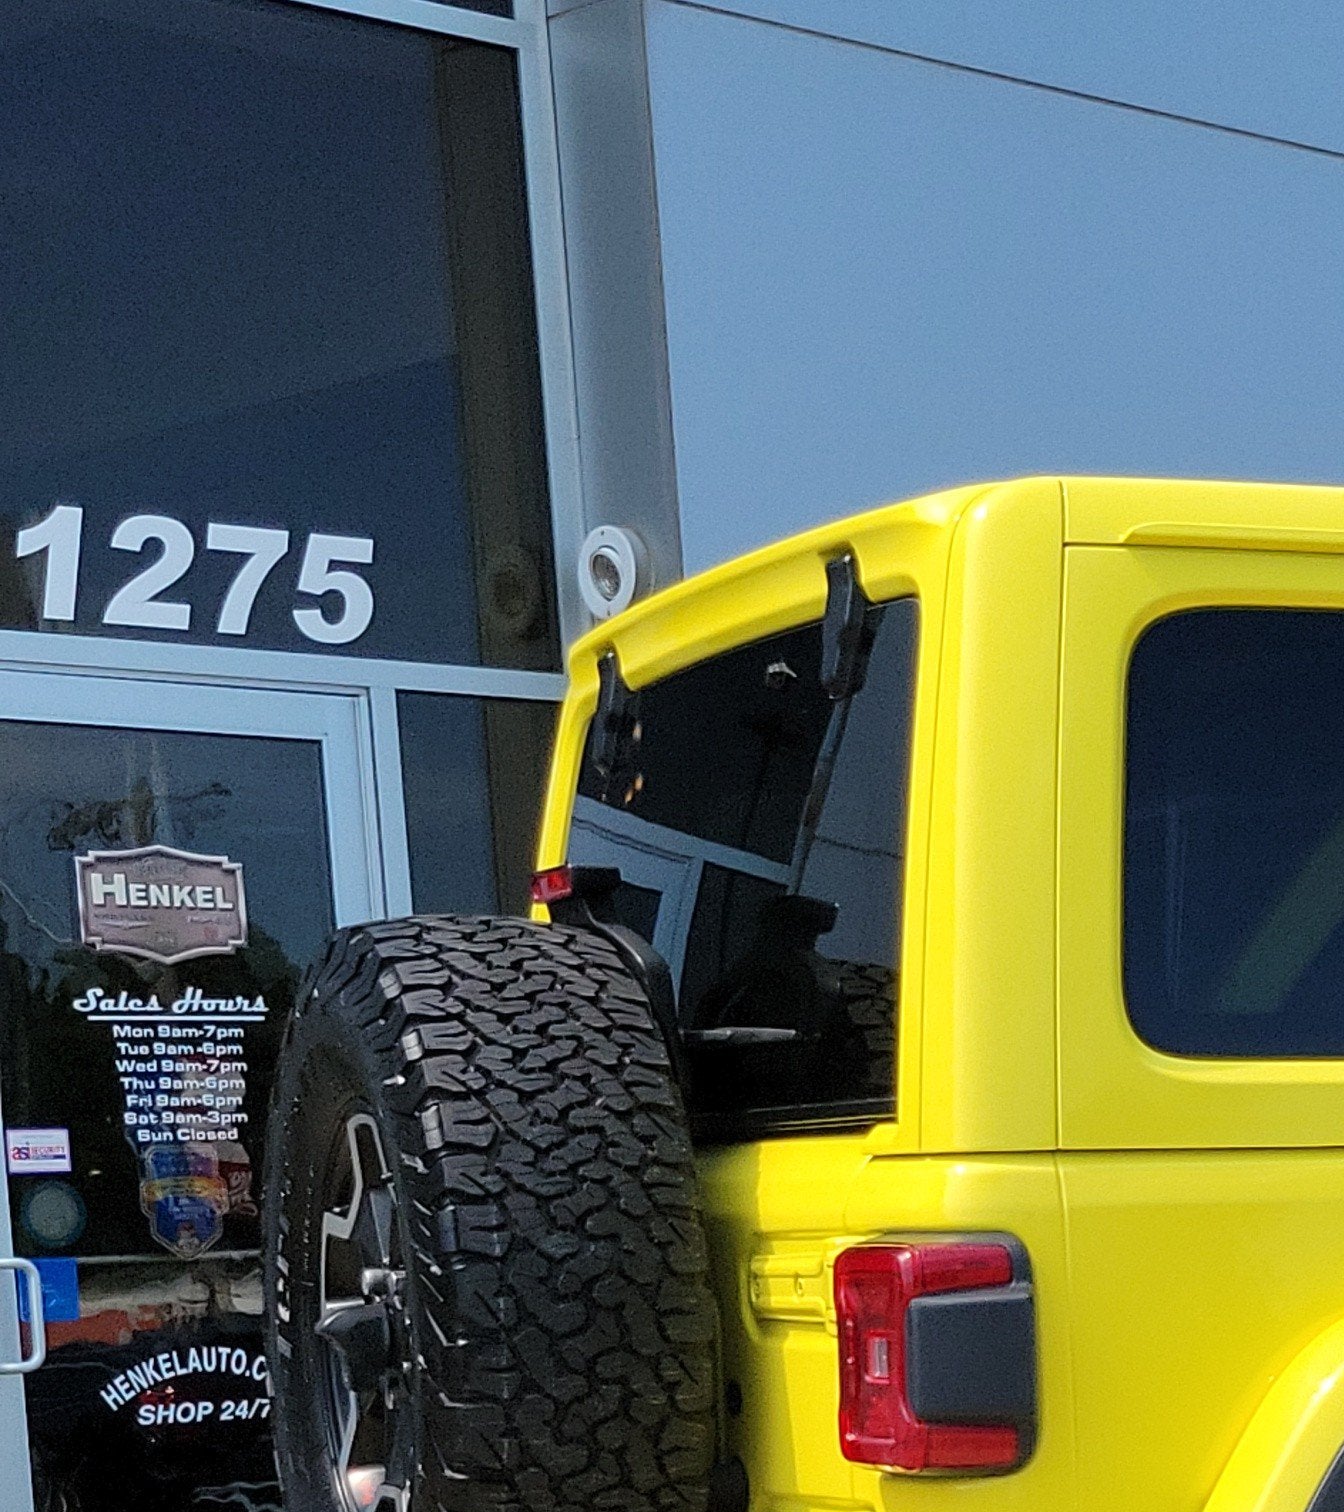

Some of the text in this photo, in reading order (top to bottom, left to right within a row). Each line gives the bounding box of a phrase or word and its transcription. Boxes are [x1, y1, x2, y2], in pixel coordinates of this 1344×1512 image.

[16, 504, 375, 645] 1275
[90, 872, 234, 910] HENKEL
[73, 986, 269, 1013] Sales Hours
[112, 1025, 244, 1040] Mon 9am-7pm
[116, 1042, 150, 1055] Tue
[115, 1059, 248, 1075] Wed 9am-7pm
[119, 1076, 155, 1090] Thu
[126, 1094, 153, 1108] Fri
[123, 1111, 248, 1127] Sat 9am-3pm
[137, 1127, 239, 1142] Sun Closed
[100, 1346, 267, 1411] HENKELAUTO.C
[137, 1397, 271, 1426] SHOP 24/7
